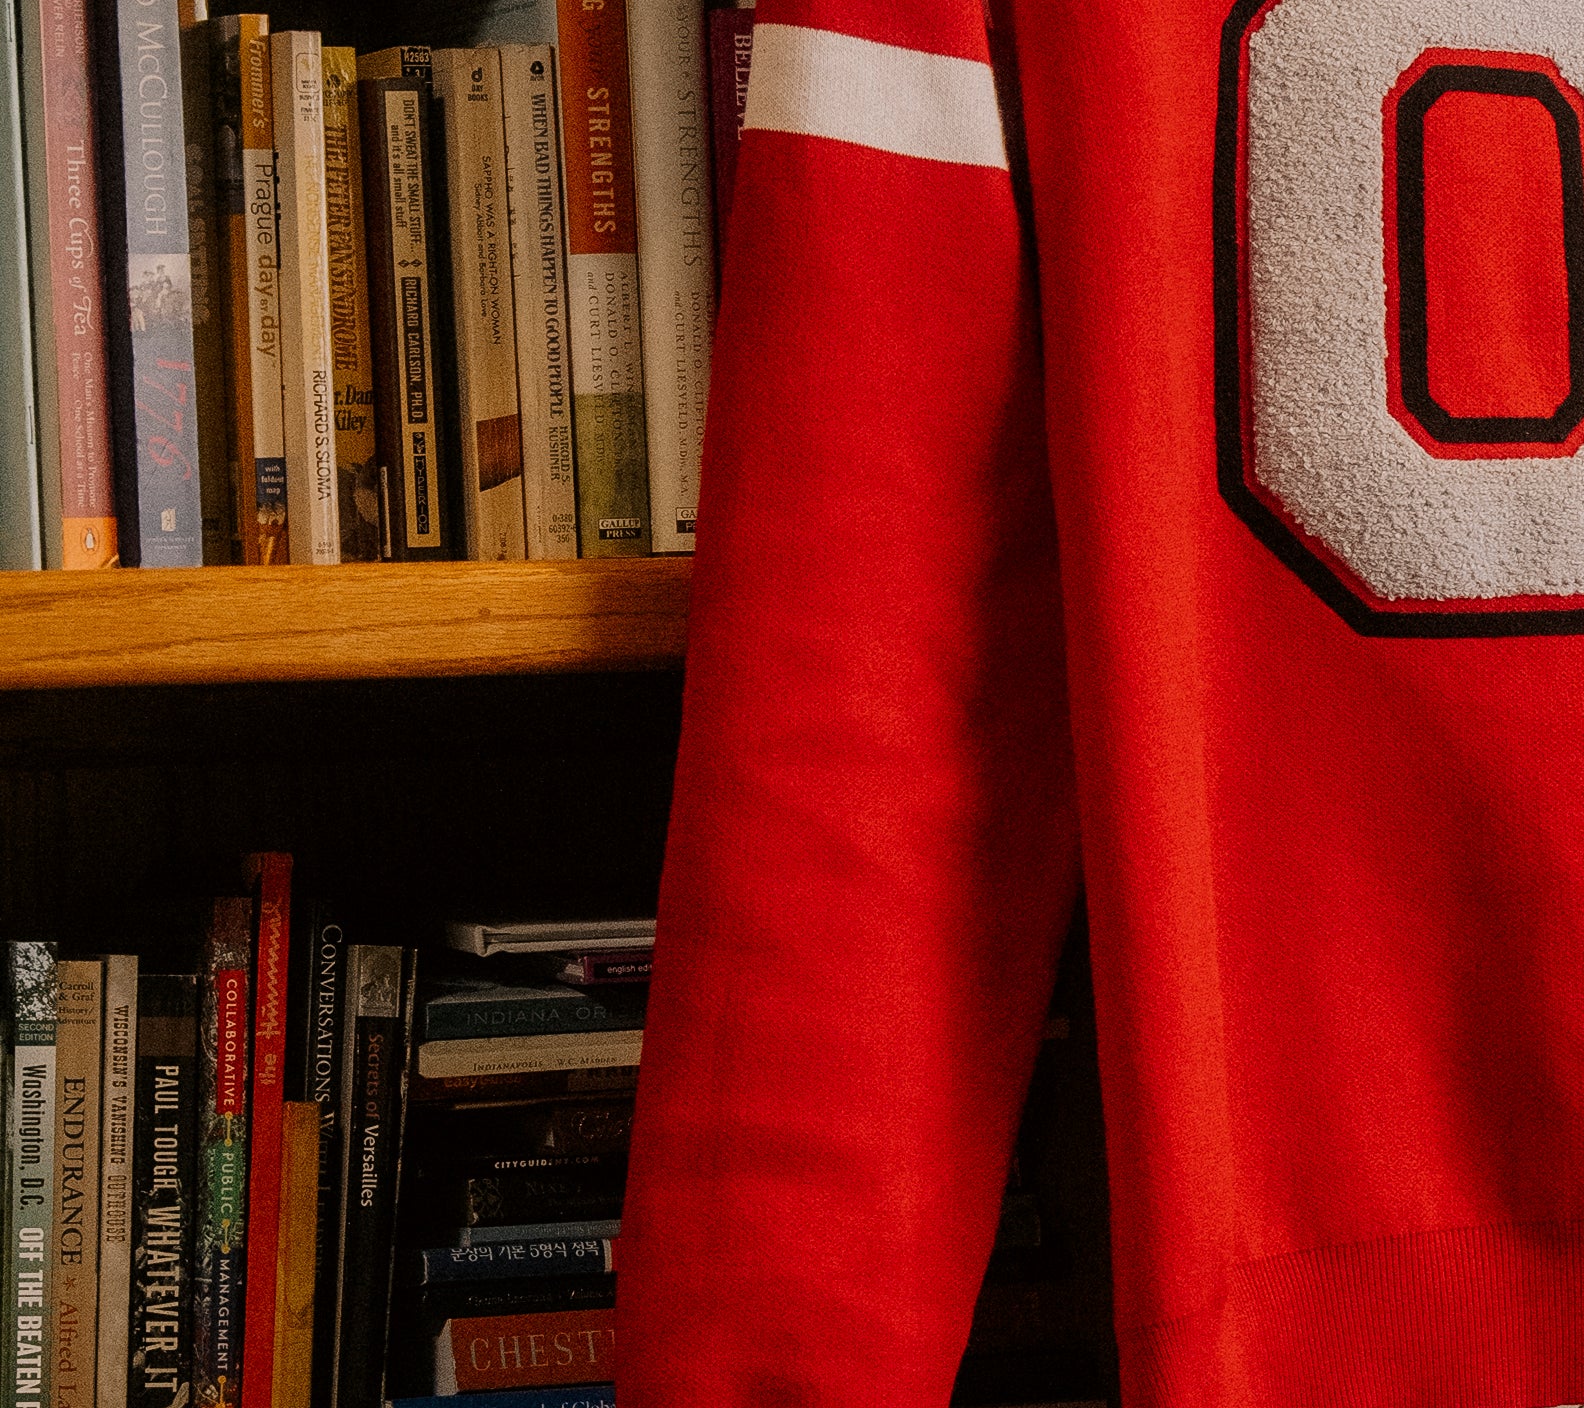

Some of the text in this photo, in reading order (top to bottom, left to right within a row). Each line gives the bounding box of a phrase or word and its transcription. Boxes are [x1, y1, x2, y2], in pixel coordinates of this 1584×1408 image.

[249, 39, 271, 129] Frommer's
[587, 87, 616, 234] STRENGTHS
[65, 140, 95, 337] Three Cups of Tea
[252, 163, 276, 244] Prague
[252, 253, 280, 296] day
[256, 315, 280, 358] day
[17, 1064, 48, 1211] Washington, D.C.
[60, 1076, 87, 1266] ENDURANCE
[151, 1065, 180, 1196] PAUL TOUGH,
[215, 979, 239, 1371] COLLABORATIVE PUBLIC MANAGEMENT
[17, 1227, 41, 1266] OFF
[146, 1205, 182, 1352] WHATEVER
[17, 1274, 41, 1309] THE
[16, 1316, 43, 1392] BEATEN
[57, 1300, 80, 1374] Alfred
[468, 1331, 615, 1372] CHEST
[145, 1364, 178, 1393] IT
